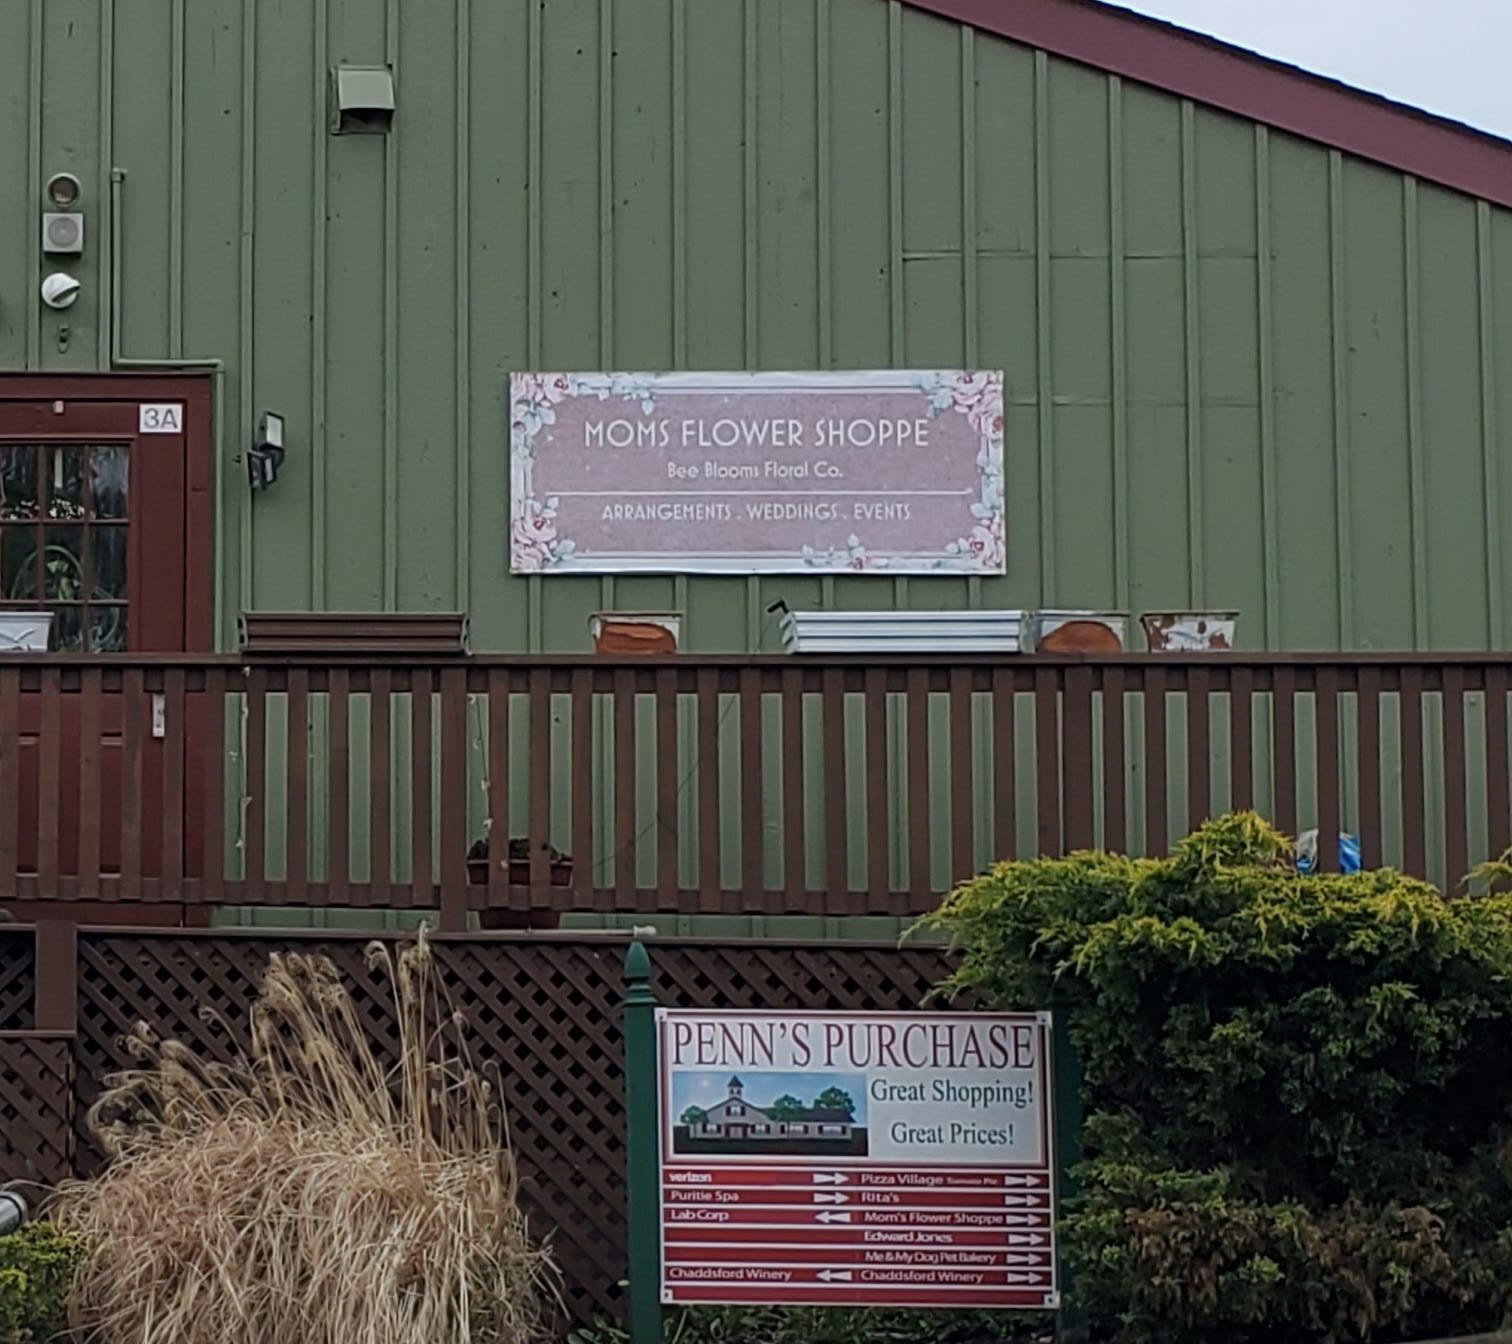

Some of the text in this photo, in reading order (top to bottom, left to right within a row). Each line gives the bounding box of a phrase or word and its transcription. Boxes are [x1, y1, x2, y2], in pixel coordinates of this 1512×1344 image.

[143, 408, 179, 429] 3A
[584, 419, 929, 448] MOMS FLOWER SHOPPE
[667, 461, 844, 478] Bee Blooms Floral Co.
[601, 503, 911, 521] ARRANGEMENTS WEDDINGS EVENTS
[672, 1022, 1035, 1070] PENN'S PURCHASE
[871, 1079, 1034, 1109] Great Shopping!
[891, 1122, 1014, 1145] Great Prices!
[669, 1172, 713, 1183] verizon
[861, 1174, 895, 1185] Pizza
[897, 1174, 944, 1187] Village
[714, 1190, 739, 1203] Spa
[861, 1192, 900, 1203] Rita's
[864, 1212, 1004, 1226] Mom's Flower Shoppe
[864, 1231, 953, 1244] Edward Jones
[914, 1252, 939, 1264] Dog
[669, 1267, 792, 1281] Chaddsford Winery
[860, 1270, 984, 1284] Chaddsford Winery
